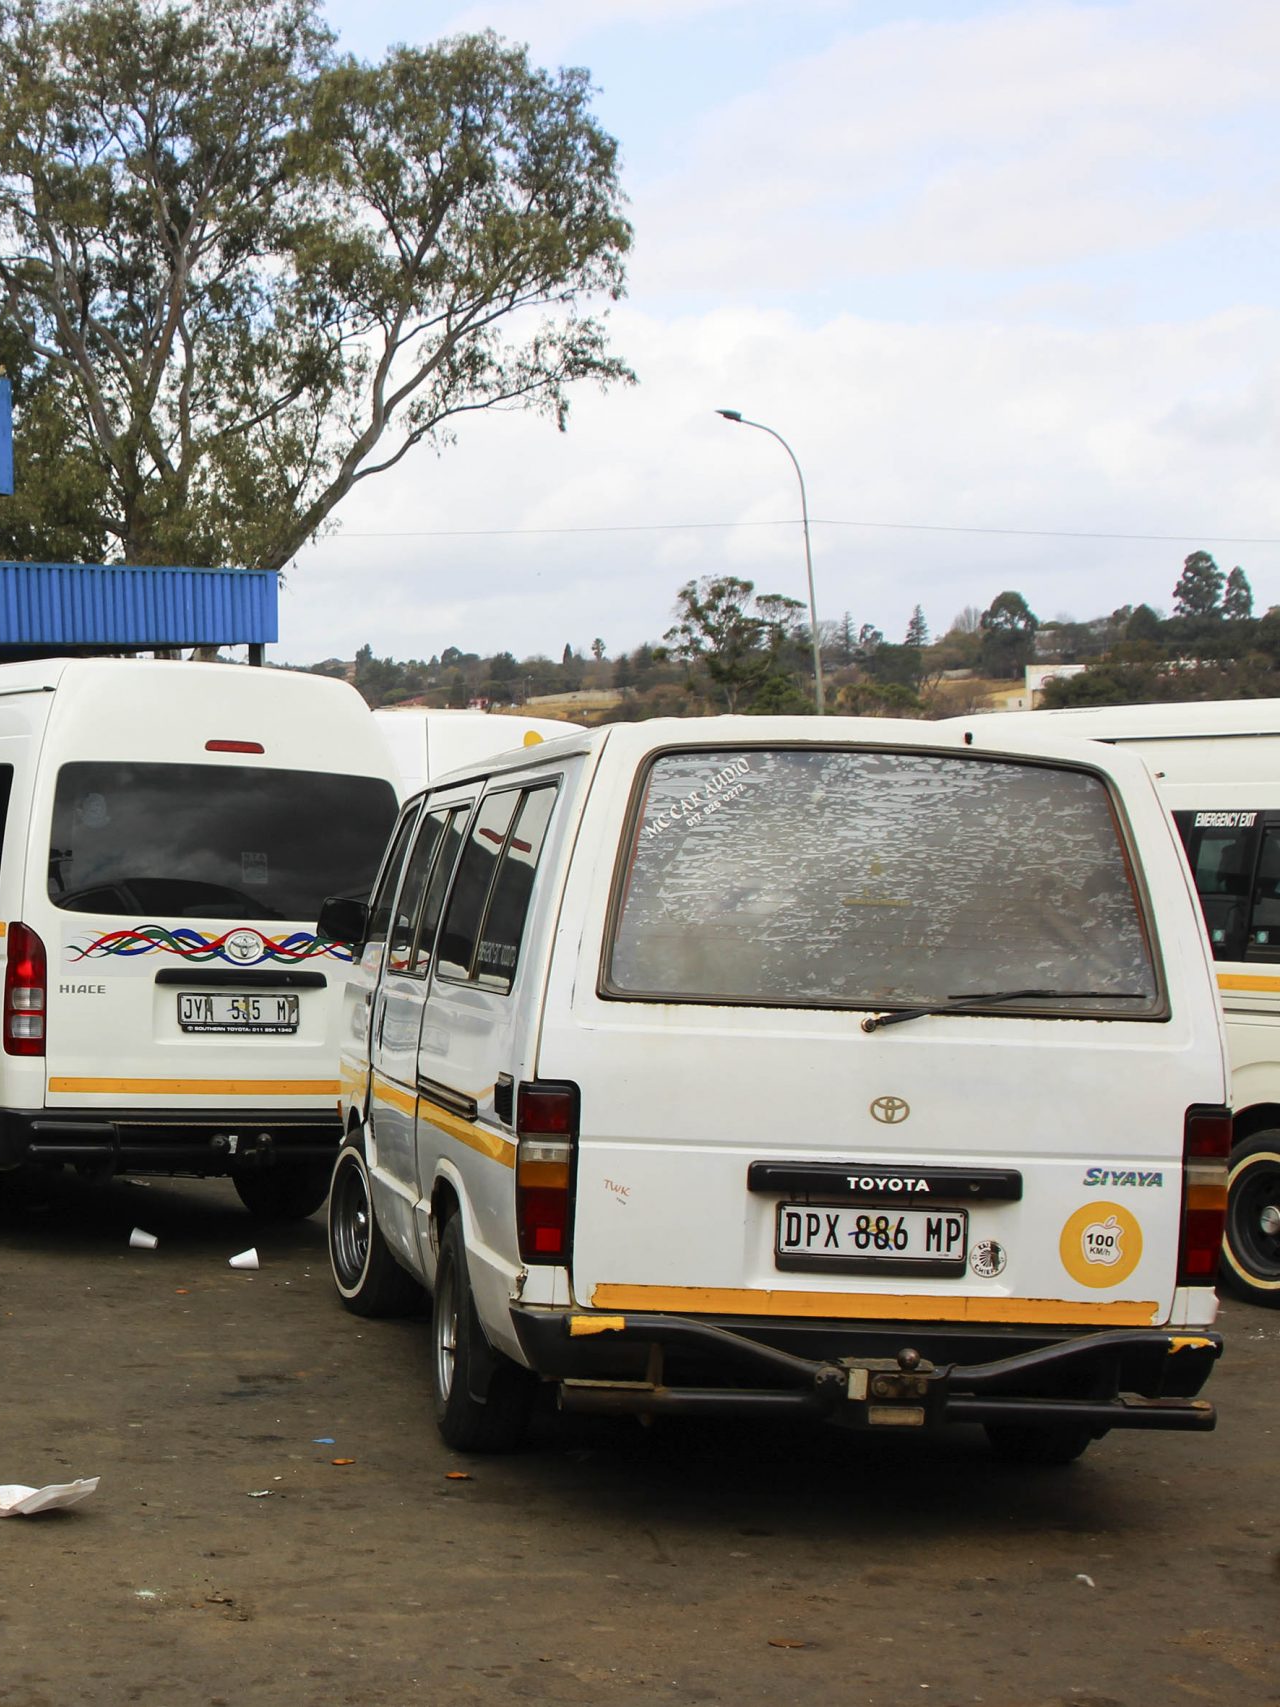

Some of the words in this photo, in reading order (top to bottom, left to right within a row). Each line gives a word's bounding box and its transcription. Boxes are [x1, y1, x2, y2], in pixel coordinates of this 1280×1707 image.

[670, 791, 703, 819] CAR
[704, 758, 750, 798] AUDIO
[1194, 813, 1240, 827] EMERGENCY
[1238, 813, 1257, 827] EXIT
[60, 985, 106, 993] HIACE
[847, 1177, 930, 1191] TOYOTA
[785, 1212, 840, 1248] DPX
[854, 1215, 908, 1250] 886
[926, 1217, 961, 1252] MP
[1086, 1233, 1114, 1247] 100
[1089, 1247, 1111, 1256] KM/h
